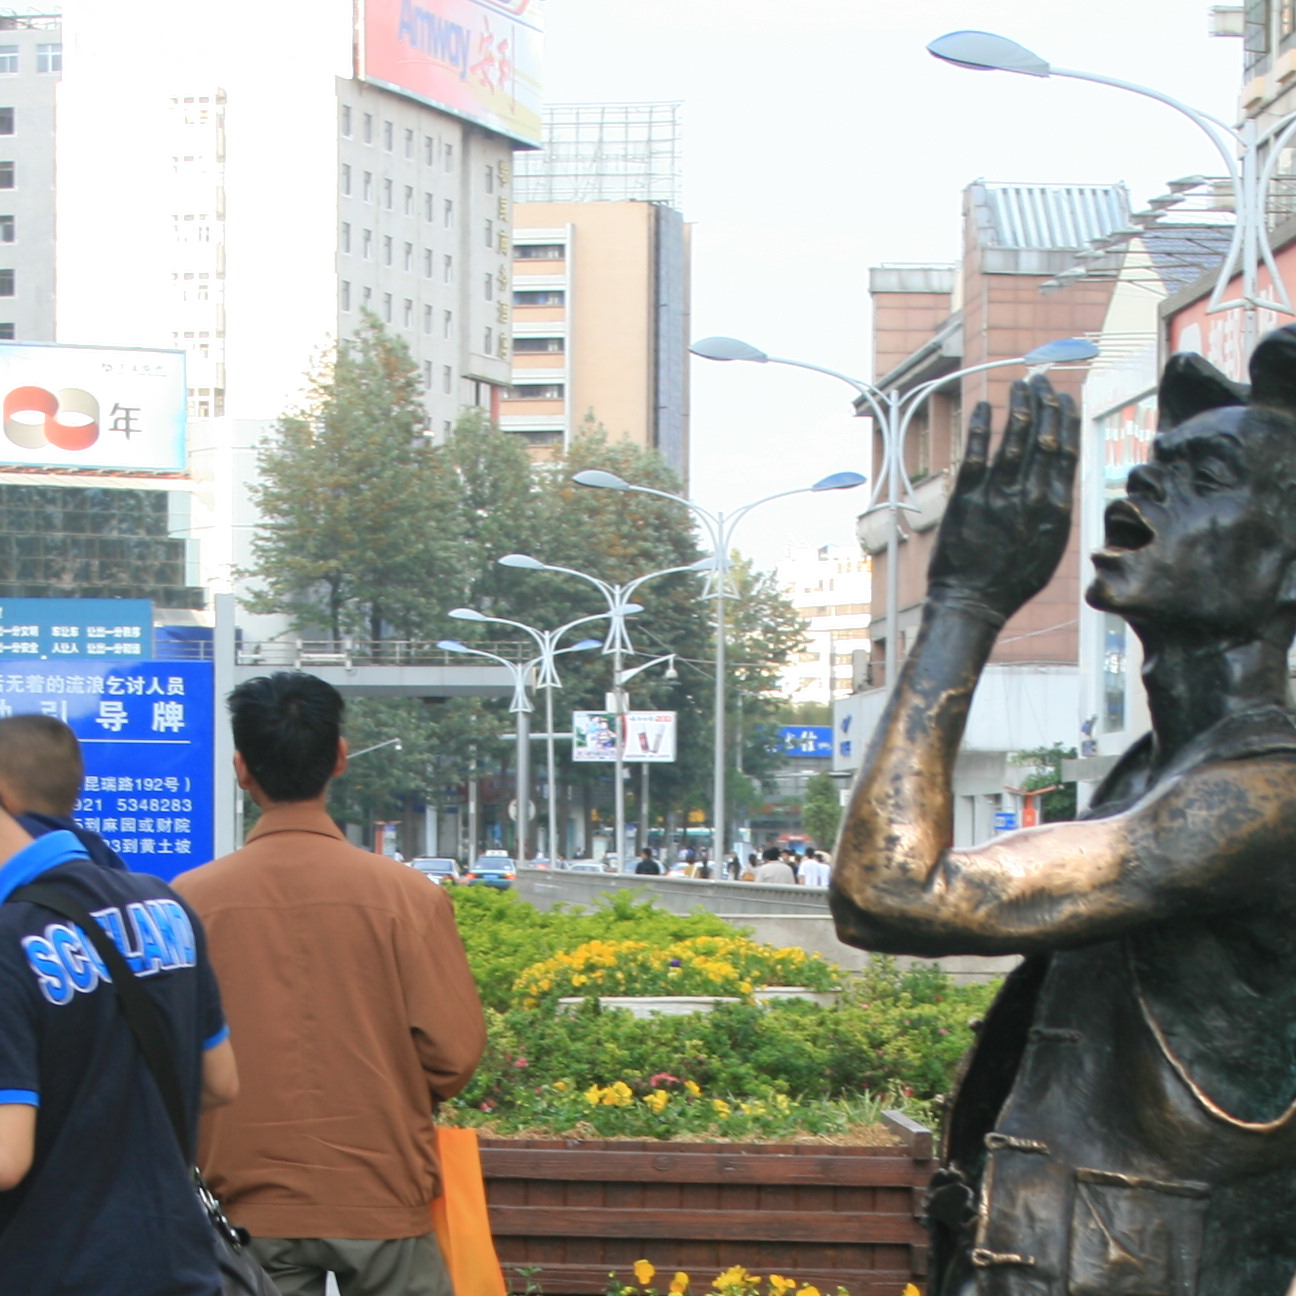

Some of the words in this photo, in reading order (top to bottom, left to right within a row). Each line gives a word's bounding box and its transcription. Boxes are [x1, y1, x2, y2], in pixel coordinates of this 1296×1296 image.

[398, 0, 471, 81] Amway
[117, 798, 192, 812] 5348283
[20, 898, 197, 1006] SCLAND
